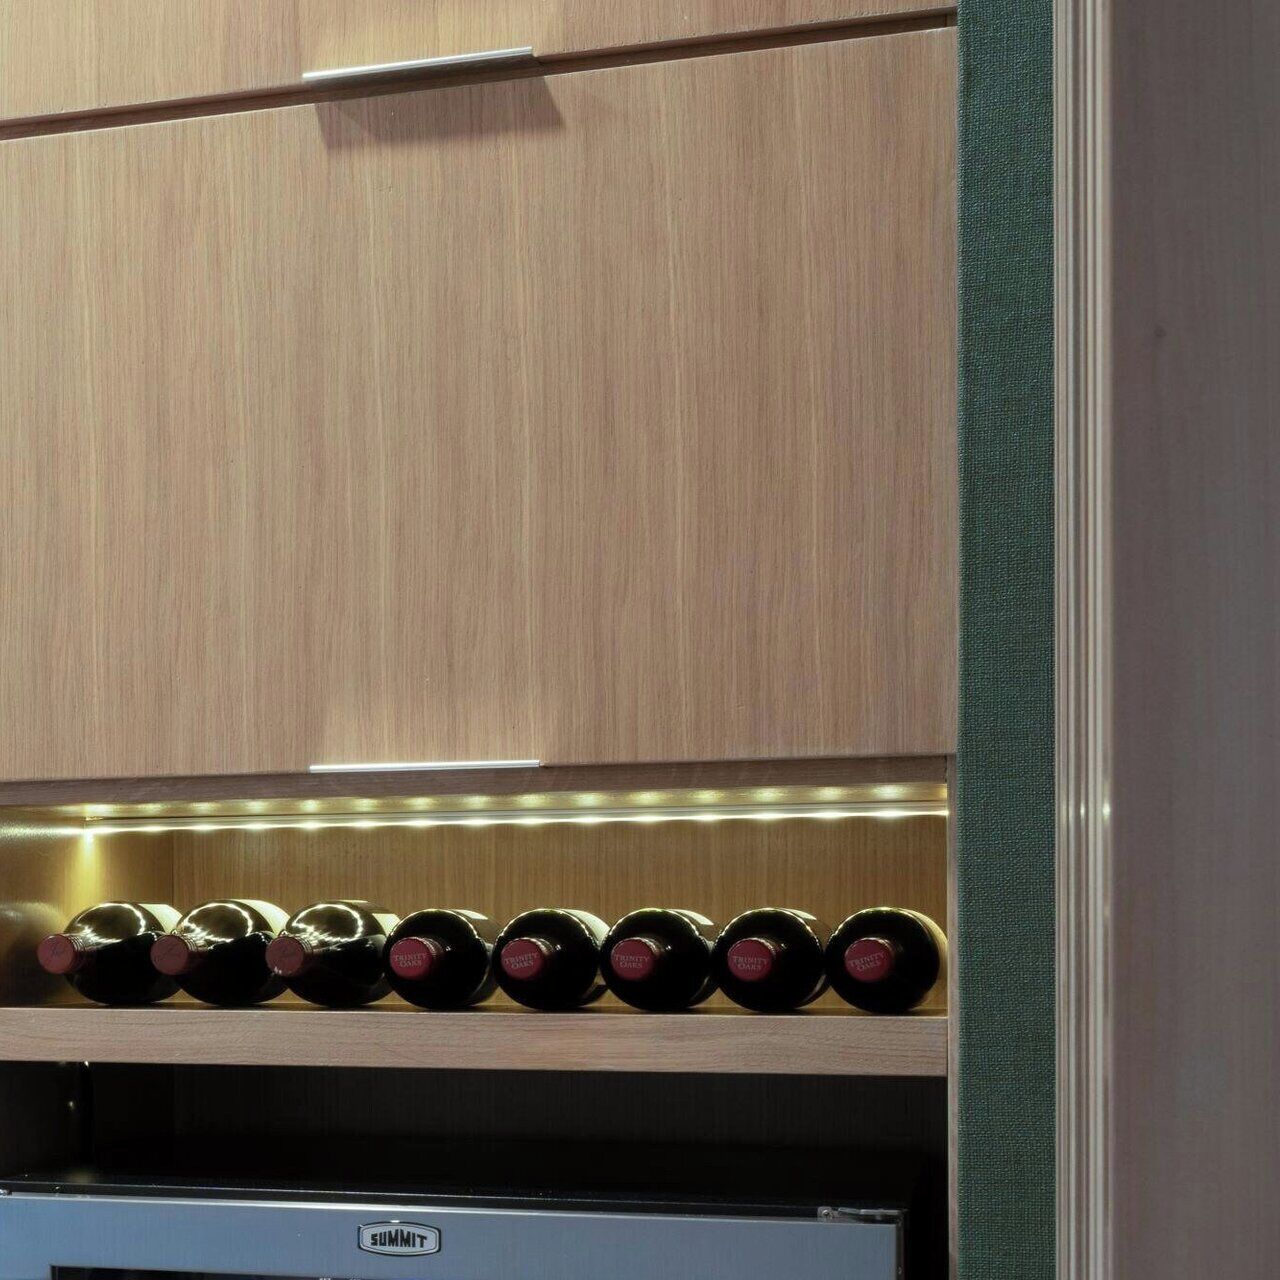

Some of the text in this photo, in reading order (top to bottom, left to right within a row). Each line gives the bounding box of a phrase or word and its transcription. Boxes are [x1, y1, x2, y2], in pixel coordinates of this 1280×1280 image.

[394, 953, 427, 962] TRINITY
[504, 952, 537, 966] TRINITY
[614, 953, 650, 962] TRINITY
[733, 955, 768, 965] TRINITY
[848, 952, 885, 967] TRINITY
[511, 960, 534, 969] OAKS
[619, 960, 643, 969] OAKS
[738, 963, 762, 971] OAKS
[857, 960, 882, 972] OAKS
[369, 1229, 428, 1248] SUMMIT
